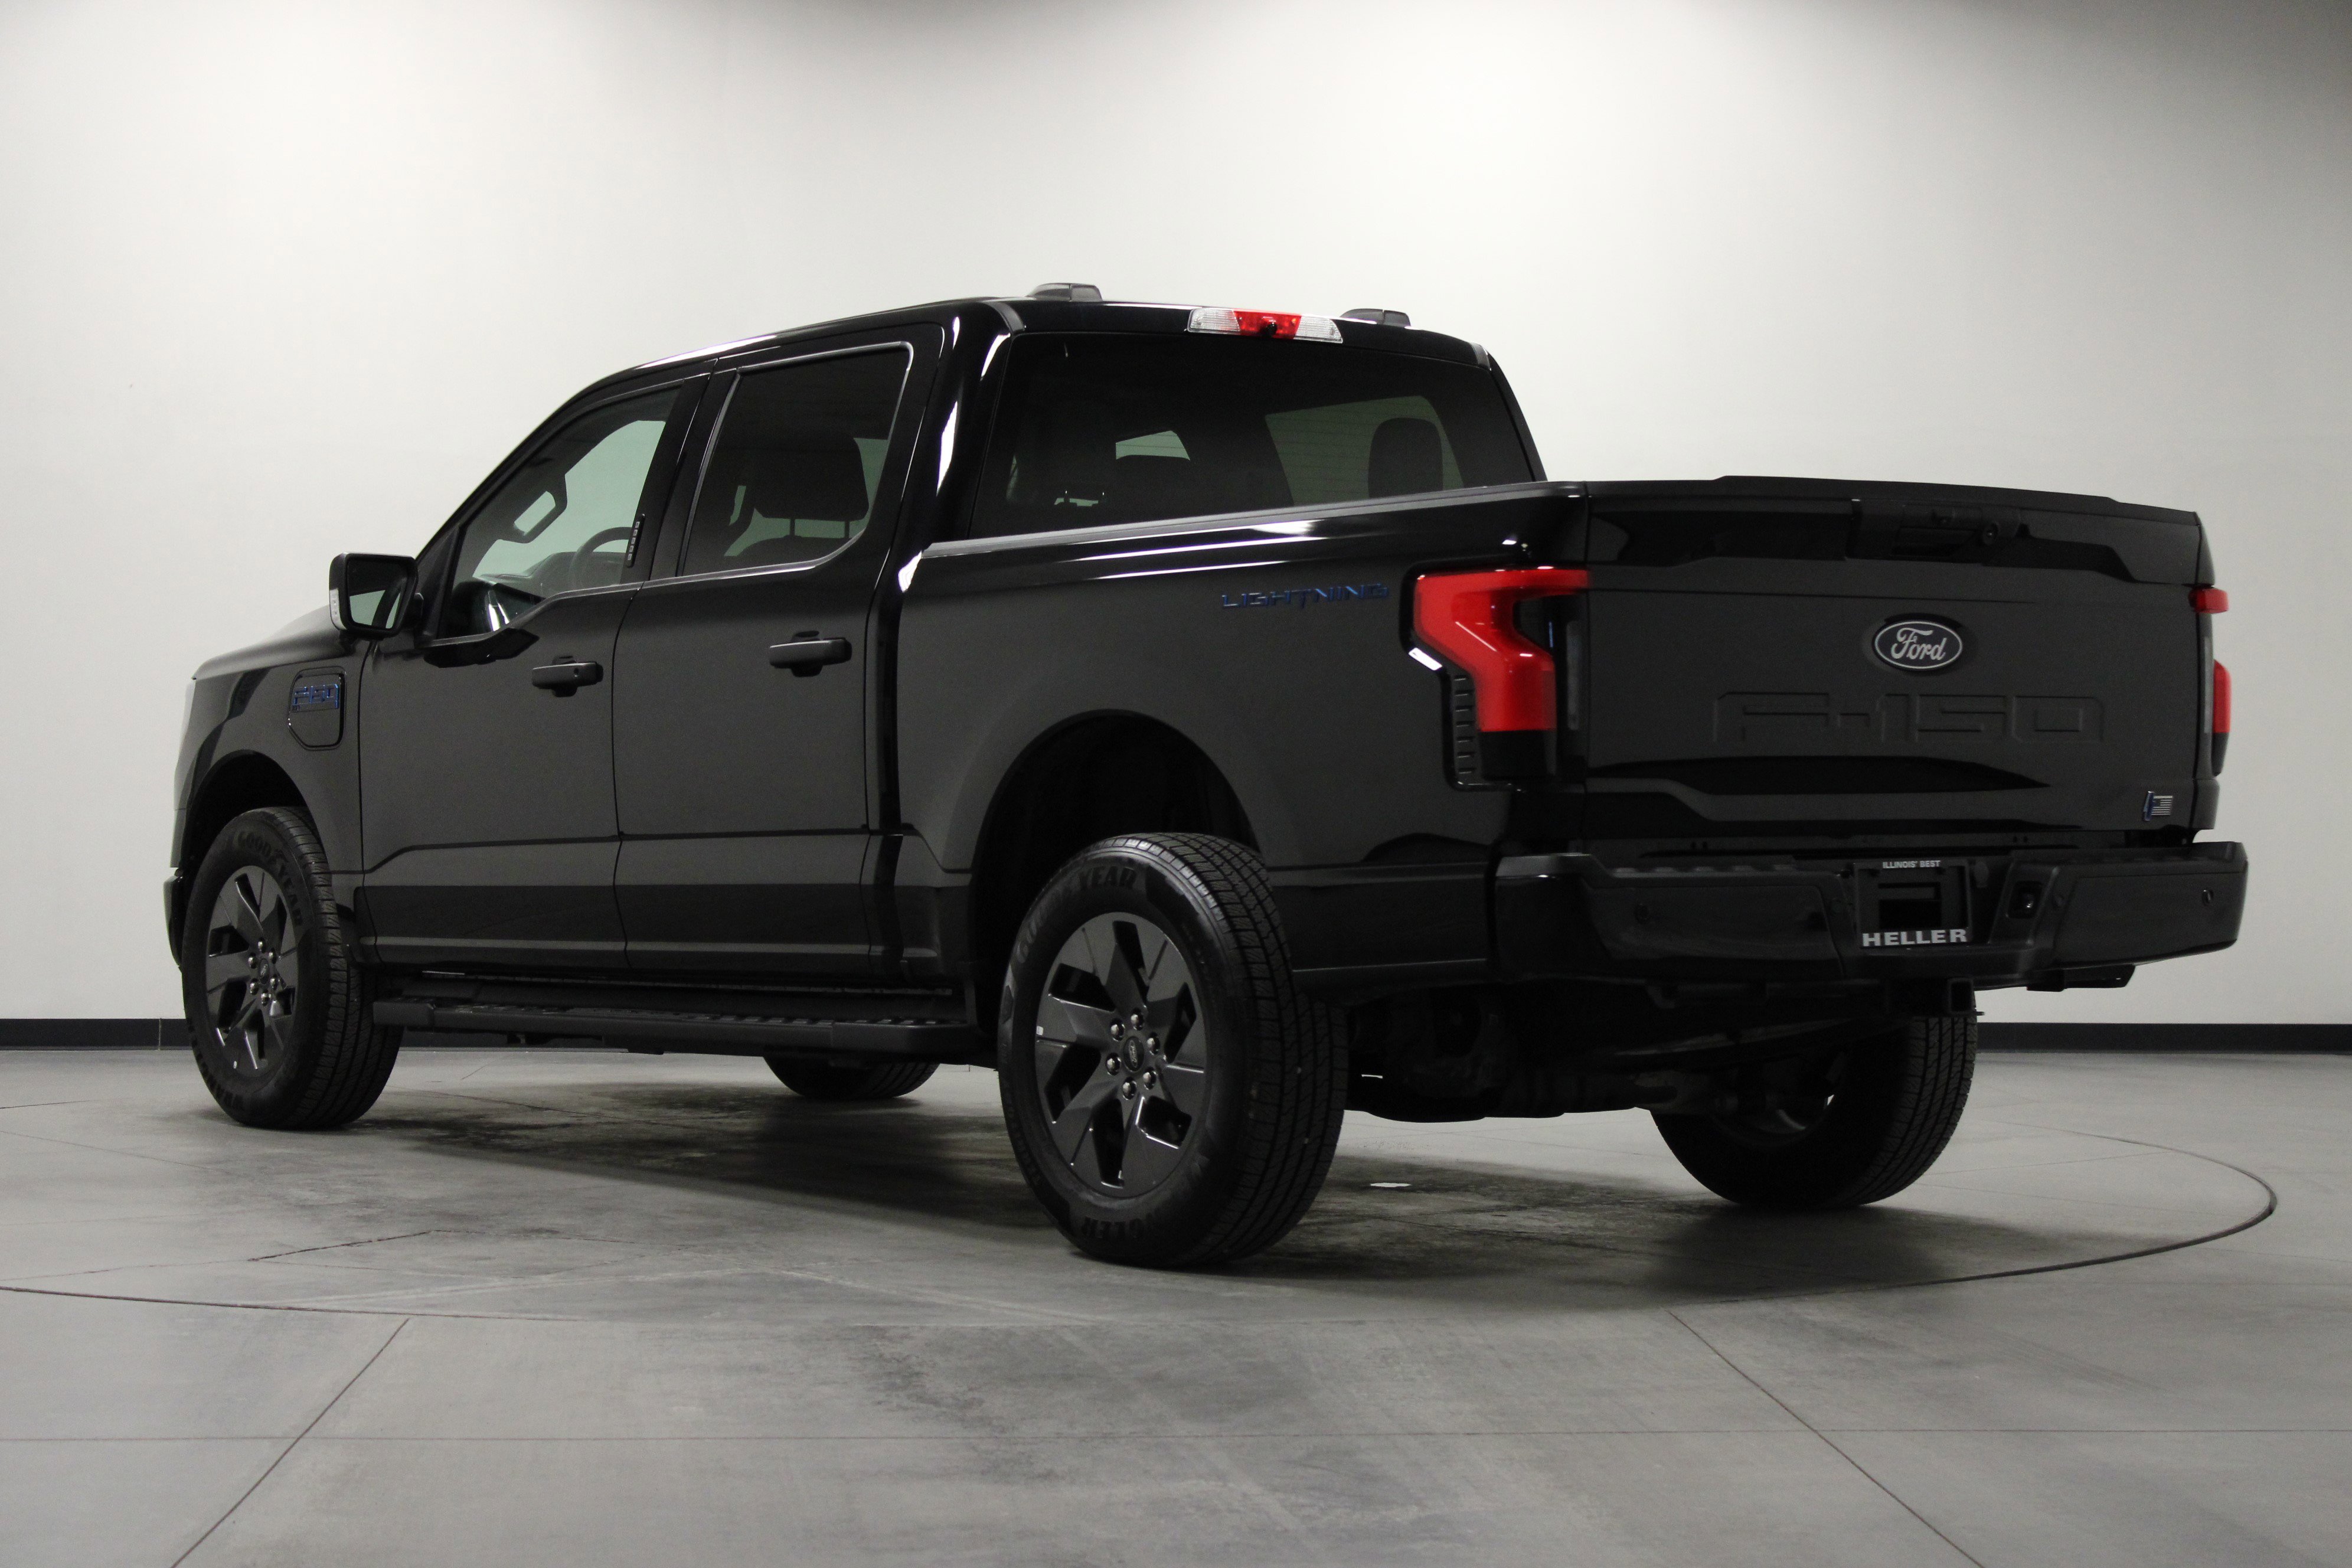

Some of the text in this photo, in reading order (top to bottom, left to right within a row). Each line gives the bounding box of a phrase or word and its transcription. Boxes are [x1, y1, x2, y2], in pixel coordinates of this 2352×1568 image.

[1221, 582, 1389, 610] LIGHTNING
[1890, 627, 1947, 661] Ford
[1713, 692, 2104, 743] F-150
[1882, 860, 1941, 869] ILLINOIS' BEST
[1862, 929, 1968, 947] HELLER
